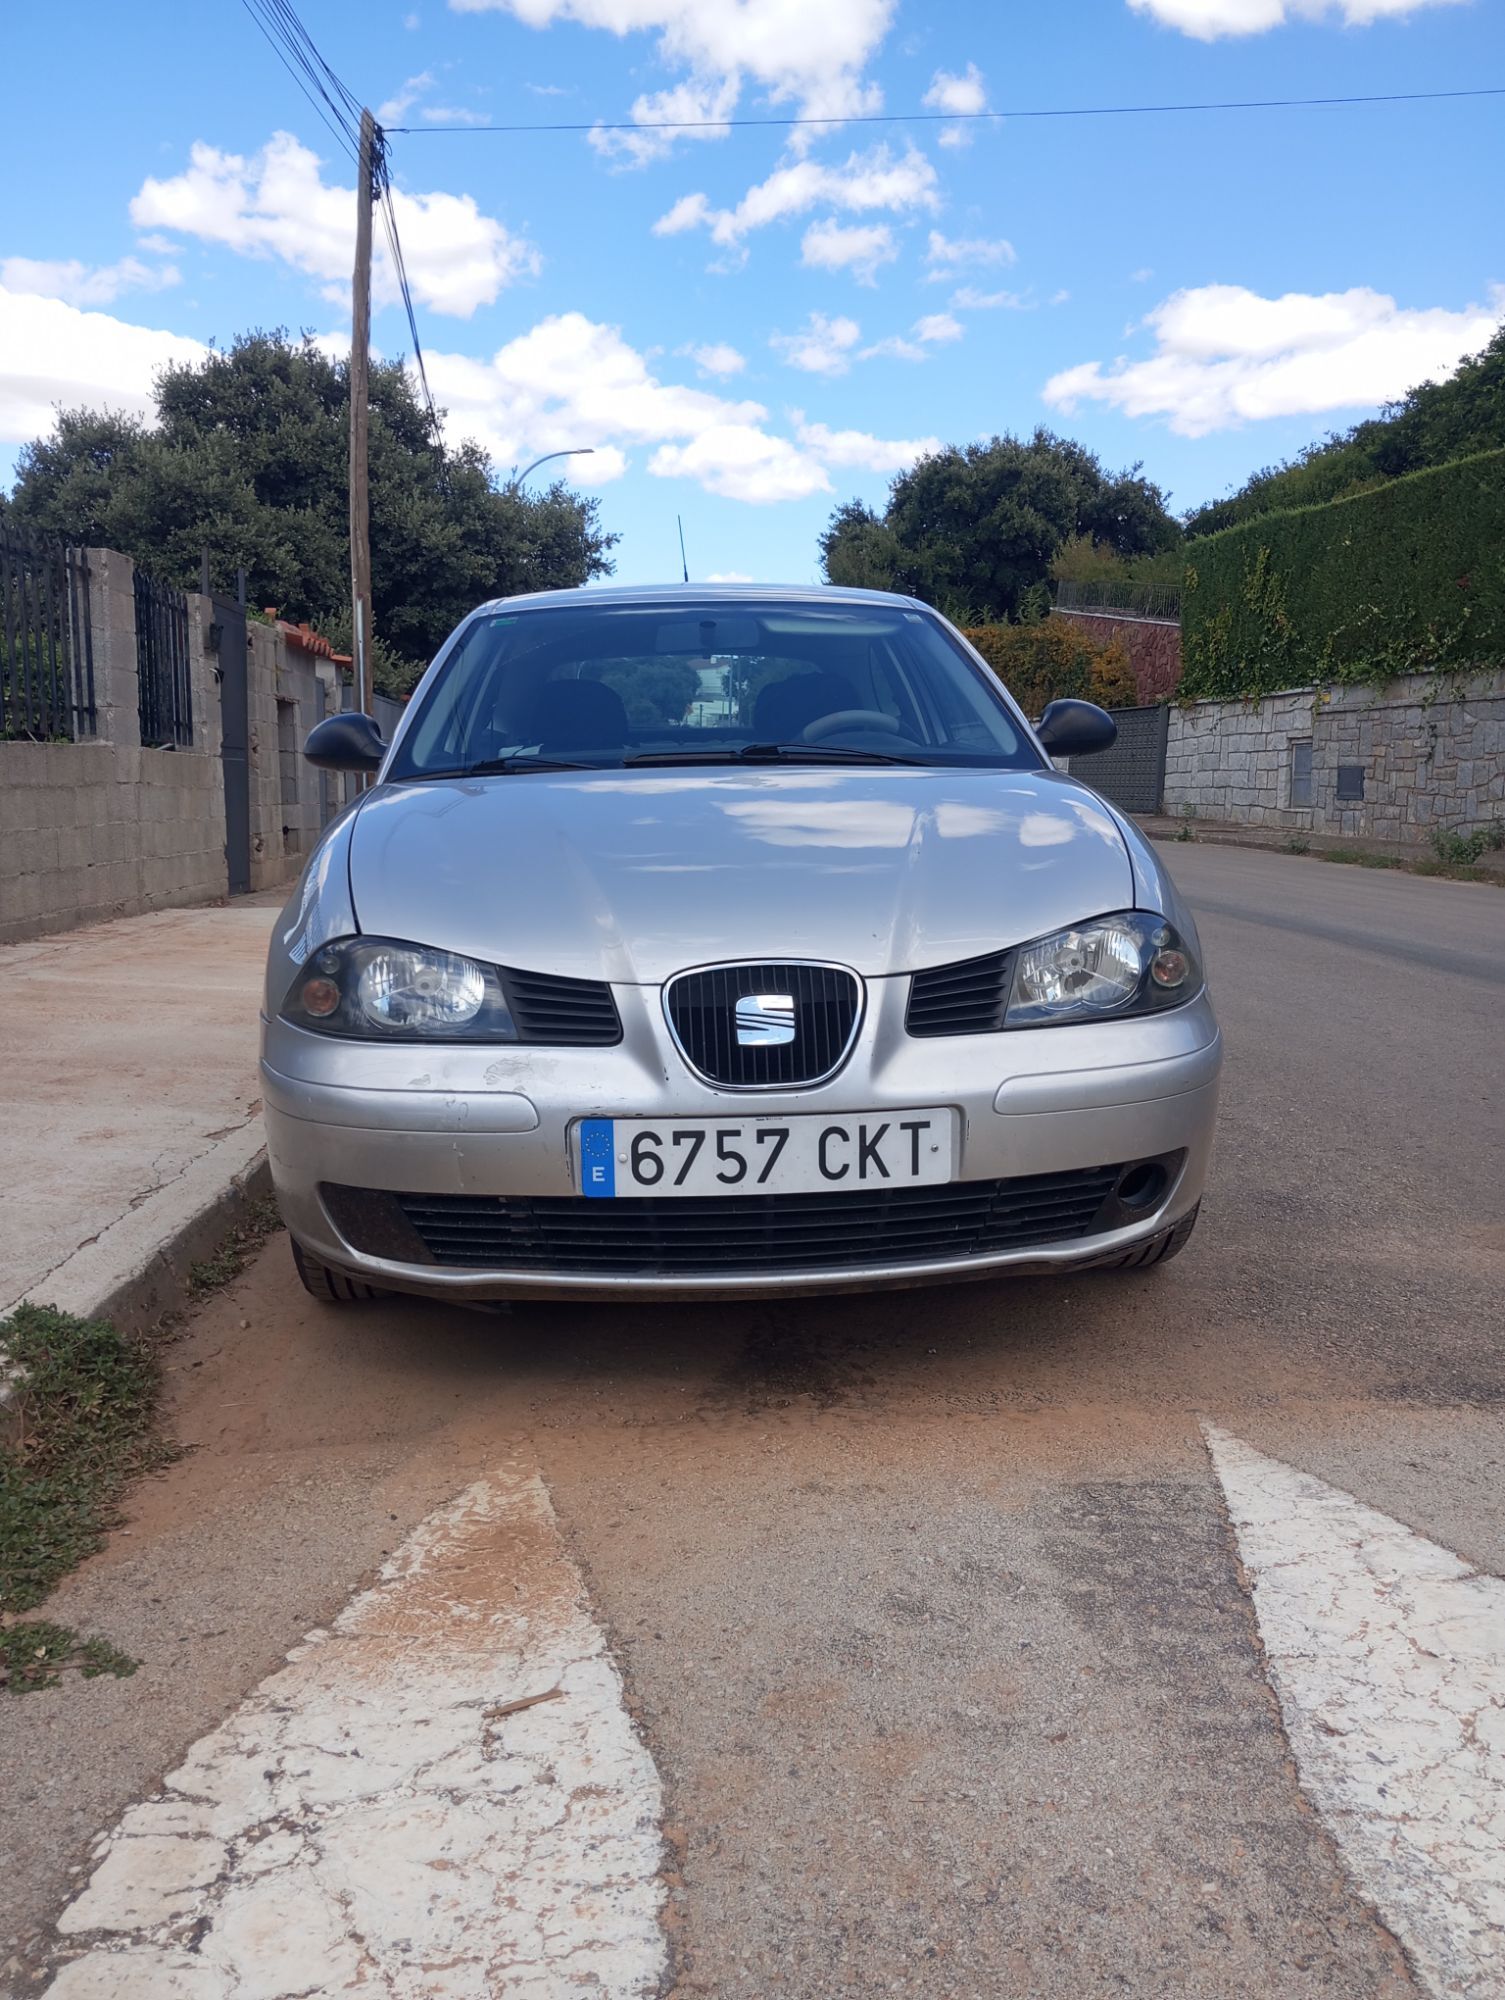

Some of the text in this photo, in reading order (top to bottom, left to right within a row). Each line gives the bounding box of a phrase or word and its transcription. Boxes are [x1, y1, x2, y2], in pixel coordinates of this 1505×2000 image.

[630, 1121, 931, 1186] 6757 CKT
[592, 1166, 606, 1182] E
